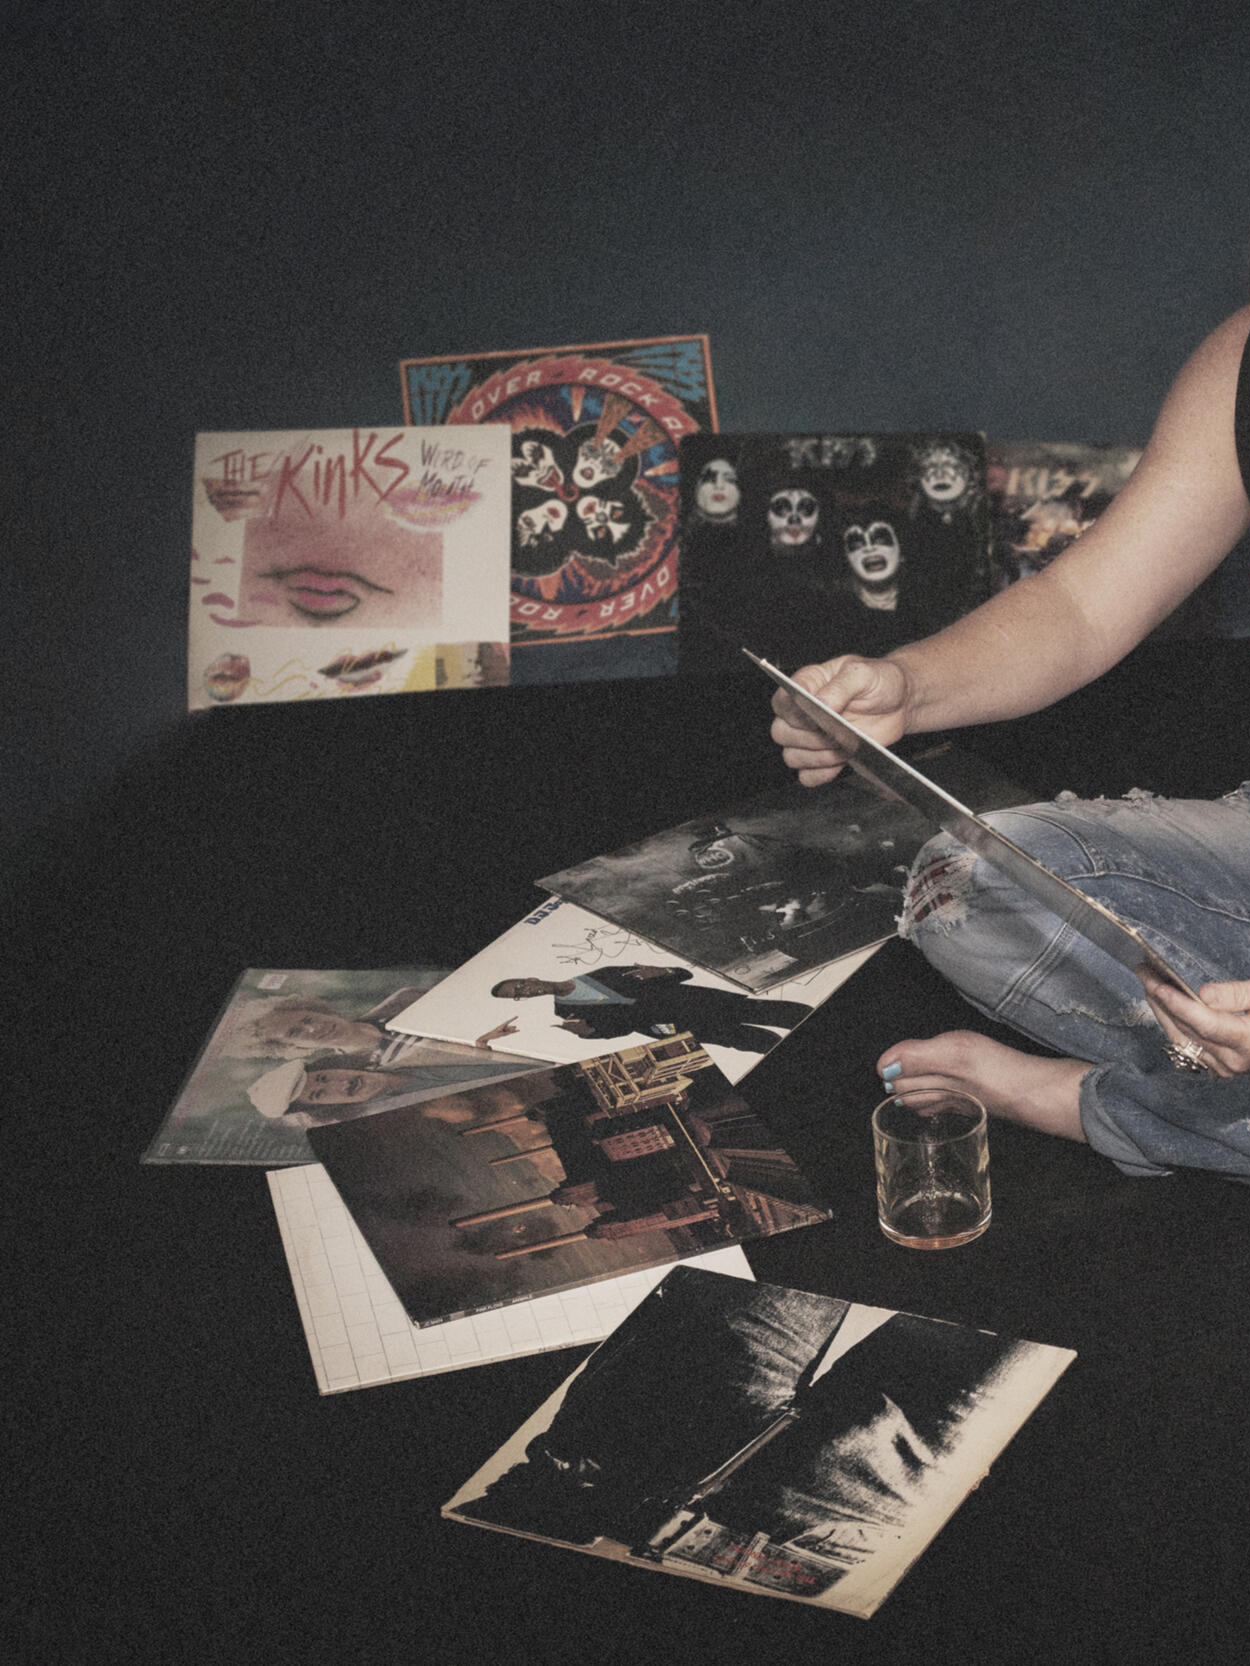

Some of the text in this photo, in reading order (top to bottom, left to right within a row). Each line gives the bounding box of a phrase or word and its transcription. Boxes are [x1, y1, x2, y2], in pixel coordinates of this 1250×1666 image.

[471, 369, 542, 420] OVER
[577, 367, 660, 407] ROCK
[209, 448, 272, 482] THE
[1006, 466, 1099, 497] KISS
[510, 566, 672, 621] OVER RO
